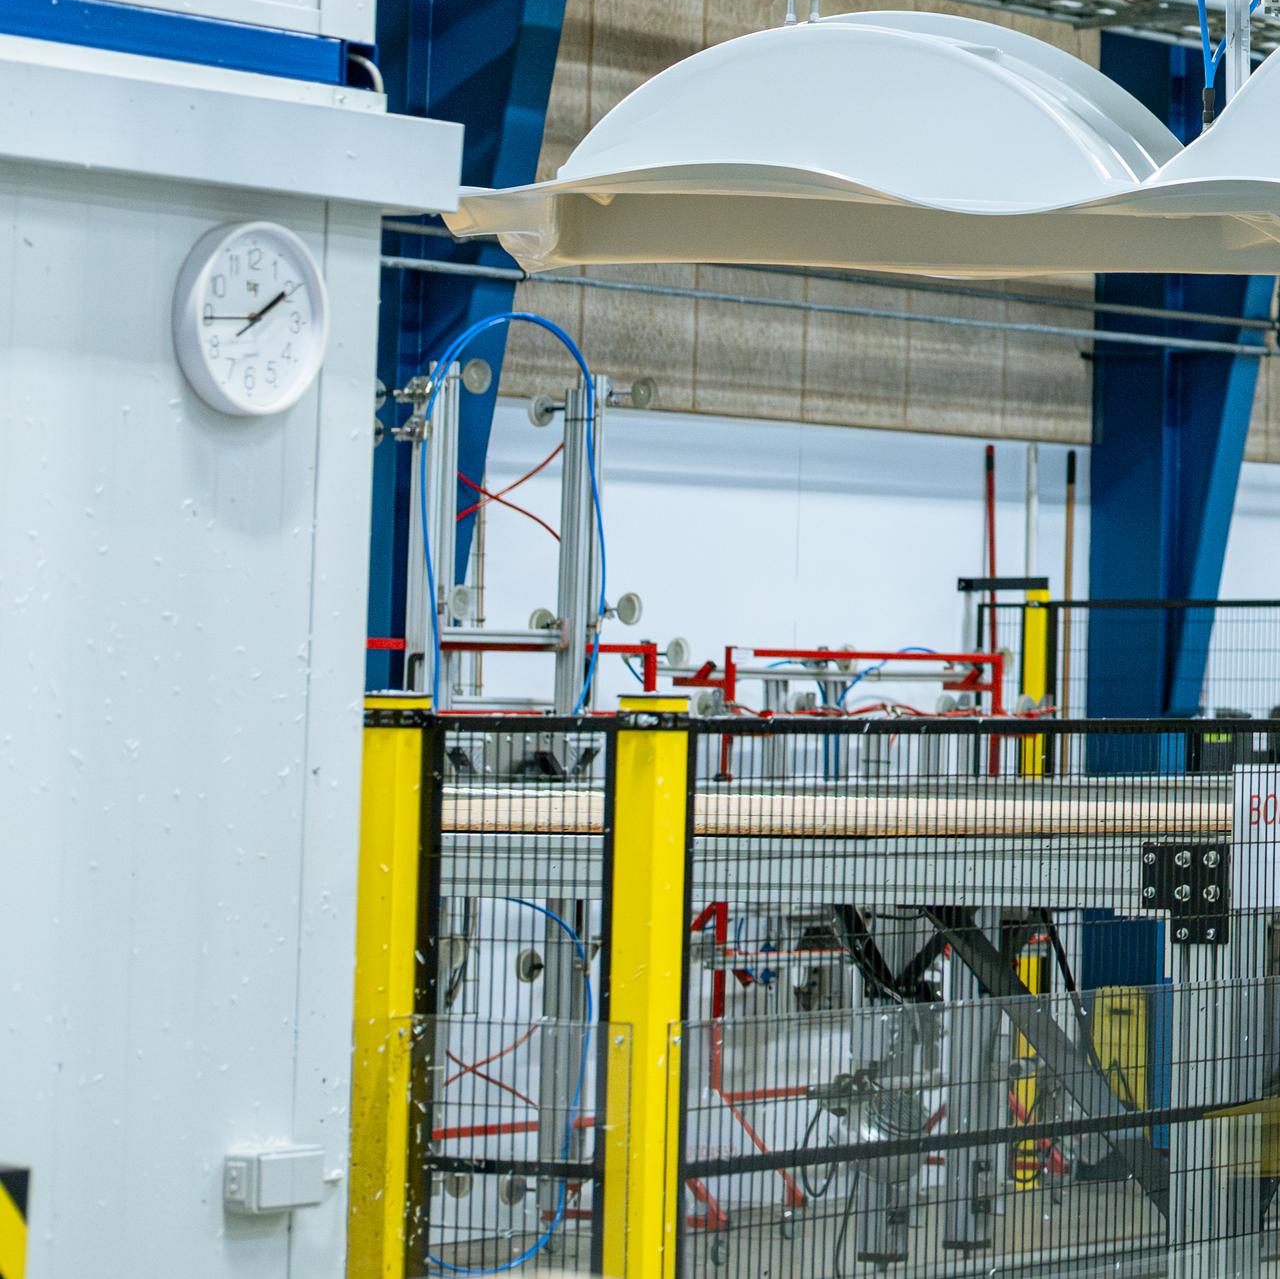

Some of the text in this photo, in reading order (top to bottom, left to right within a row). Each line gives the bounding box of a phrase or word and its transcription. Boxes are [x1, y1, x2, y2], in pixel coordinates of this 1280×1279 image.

[248, 247, 263, 271] 12
[211, 273, 225, 298] 10
[290, 311, 301, 334] 3
[209, 335, 220, 359] 8
[281, 341, 292, 360] 4
[224, 356, 237, 381] 7
[244, 366, 256, 390] 6
[266, 360, 278, 384] 5
